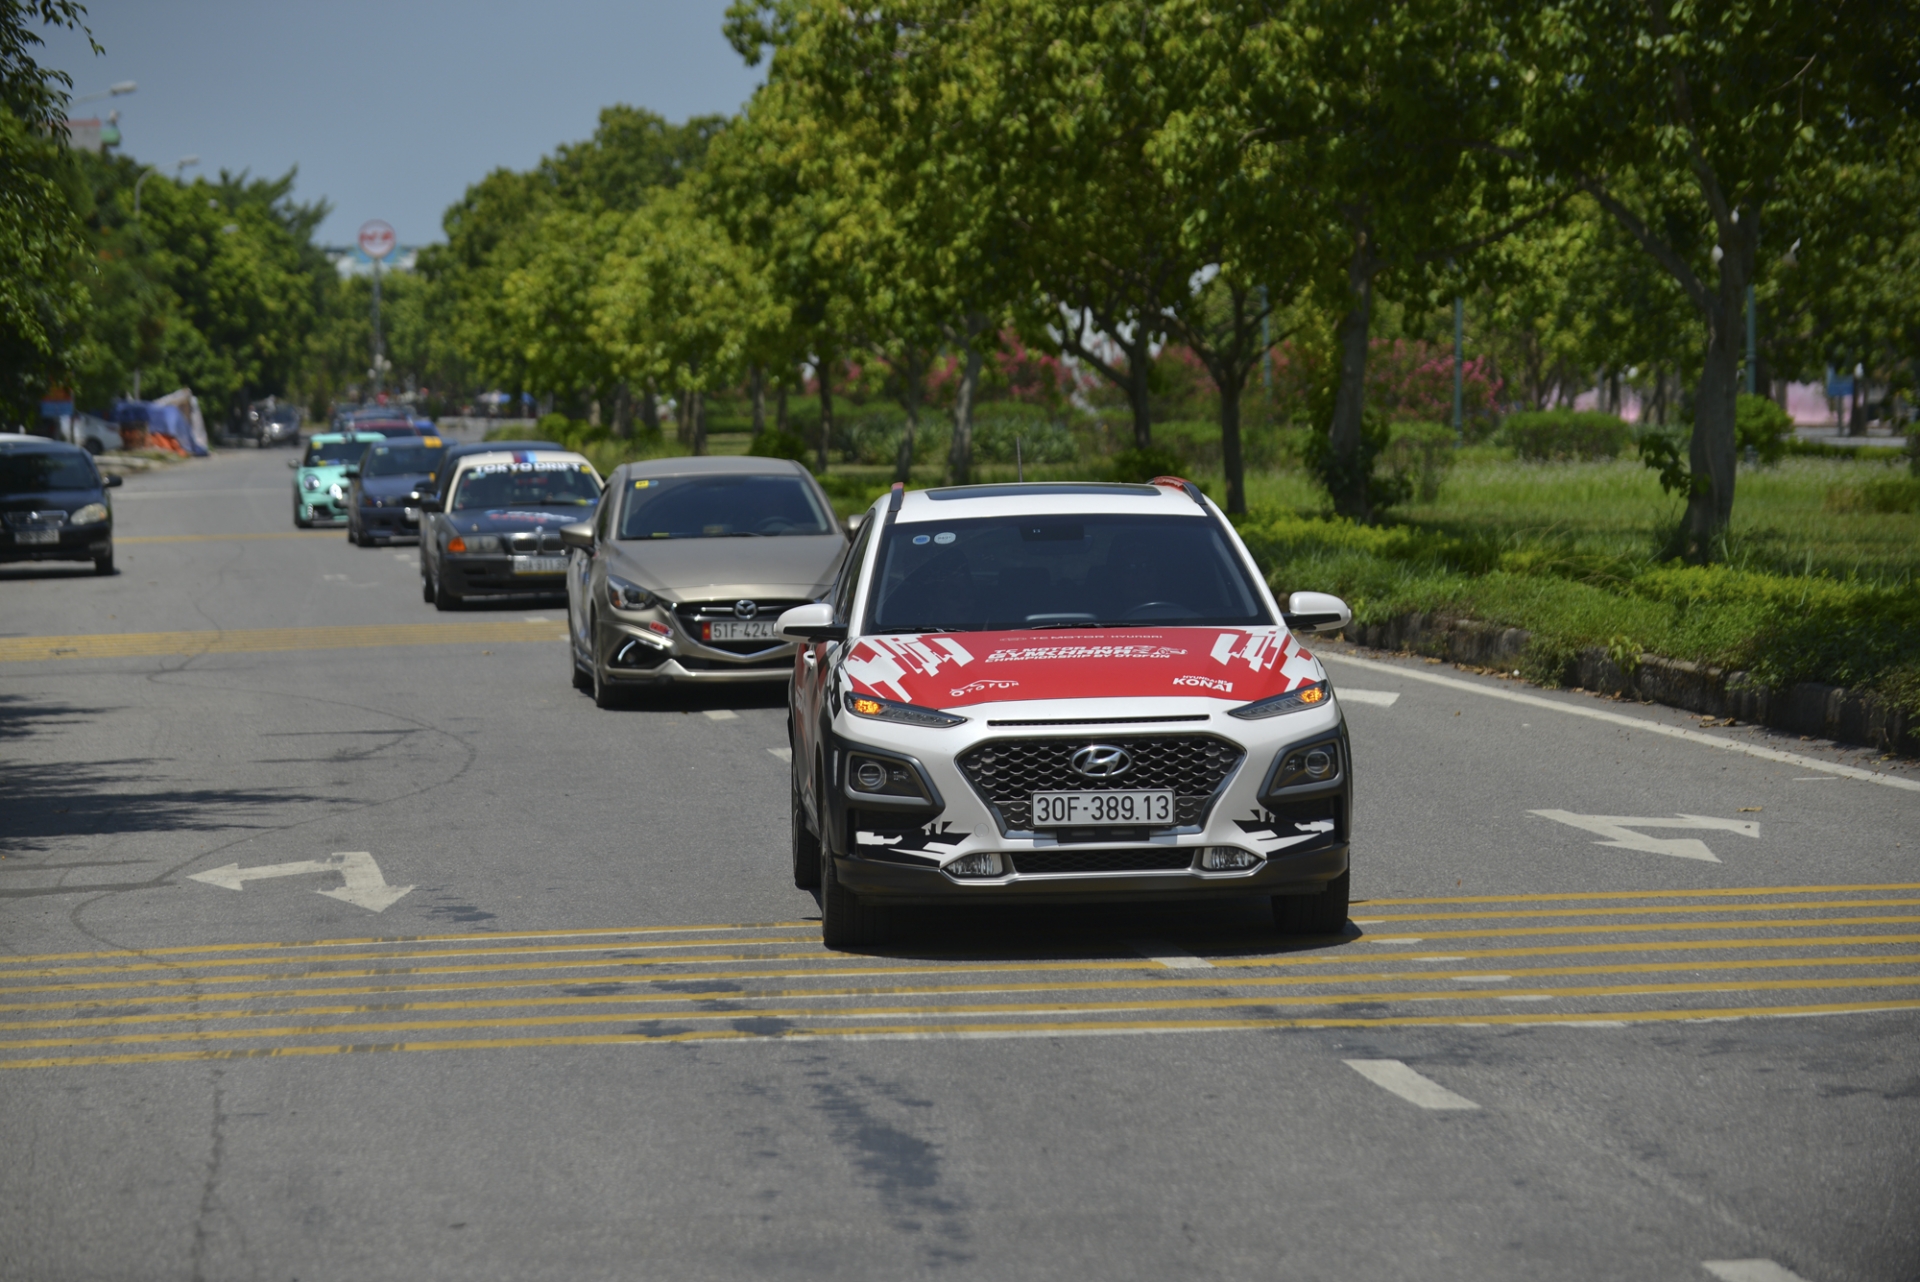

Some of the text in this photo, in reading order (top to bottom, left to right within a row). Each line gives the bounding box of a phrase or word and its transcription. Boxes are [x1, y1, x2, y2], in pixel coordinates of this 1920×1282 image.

[474, 461, 581, 474] TOKYO DRIFT
[1036, 795, 1169, 821] 30F-389.13
